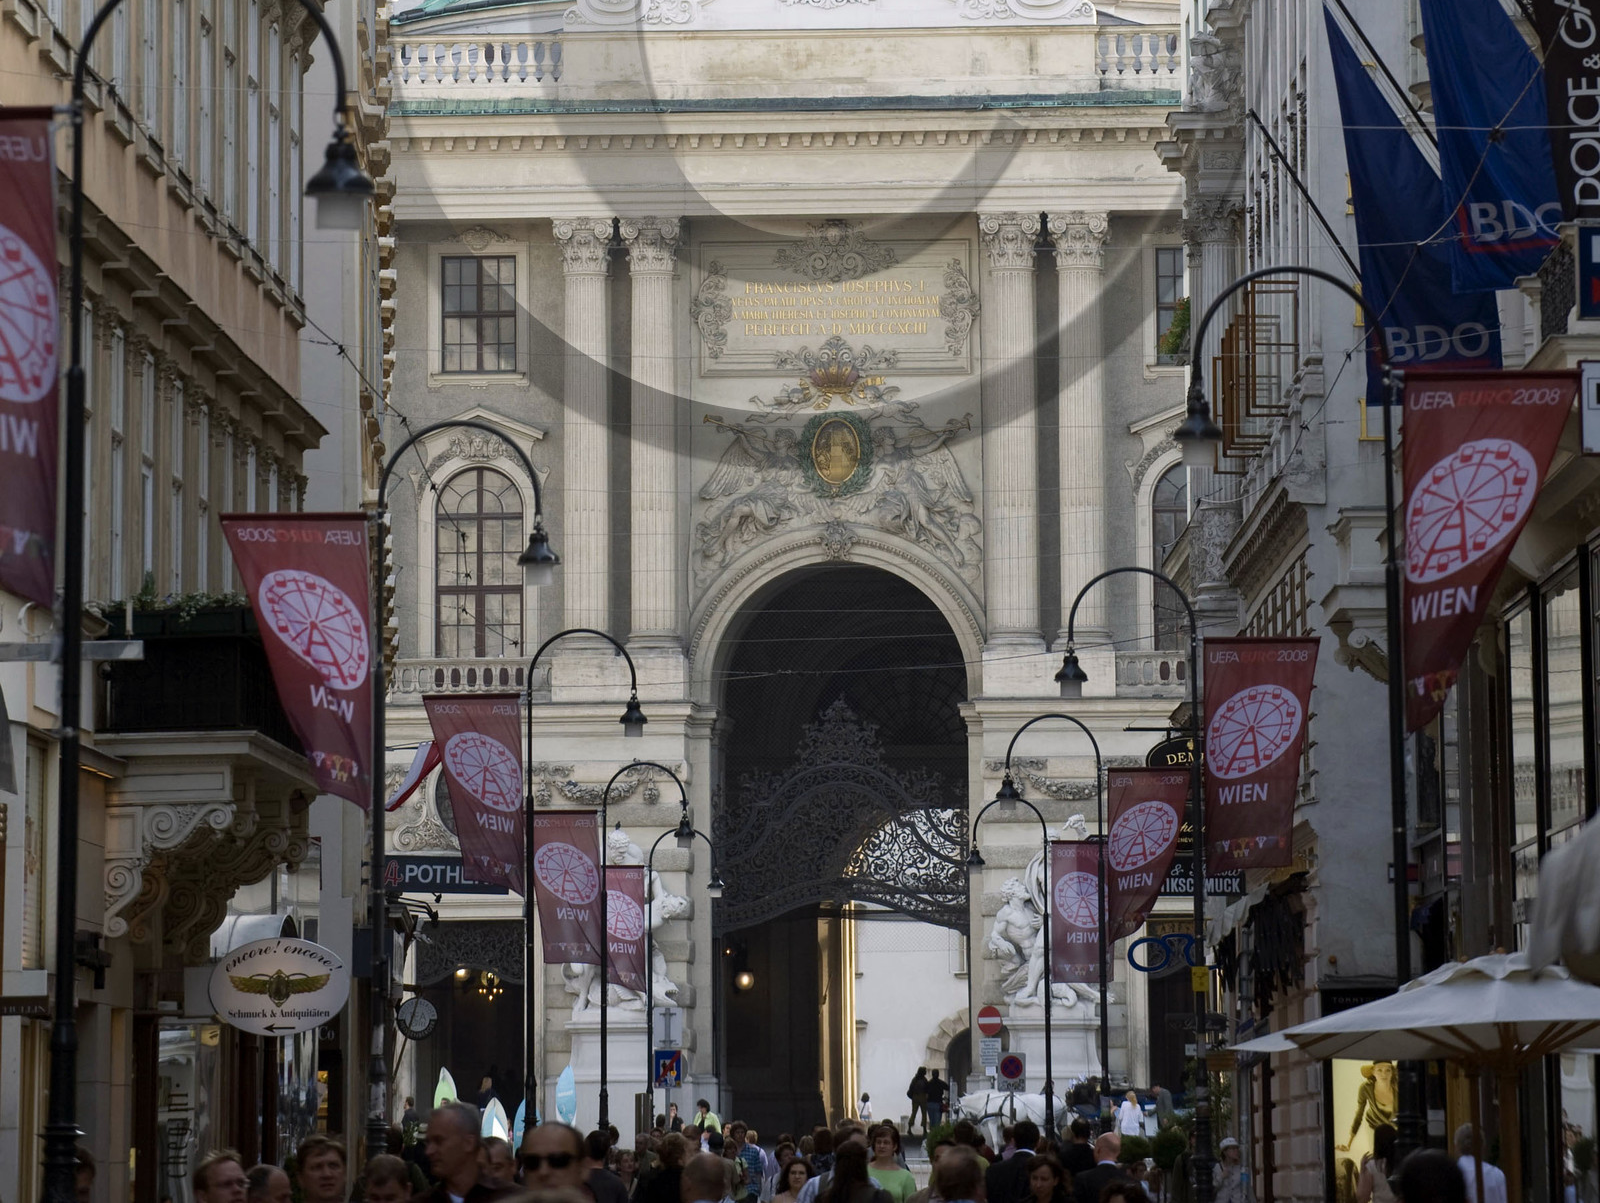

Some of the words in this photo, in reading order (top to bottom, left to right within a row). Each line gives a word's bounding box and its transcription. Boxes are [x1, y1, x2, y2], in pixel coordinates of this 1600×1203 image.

[1567, 77, 1600, 205] DOLCE
[745, 281, 834, 294] FRANCISCVS
[842, 280, 912, 293] IOSEPHVS
[744, 323, 811, 335] PERFECIT
[849, 321, 928, 334] MDCCCXCIII
[1384, 322, 1490, 362] BDO
[1409, 390, 1455, 411] UEFA
[1511, 387, 1562, 405] 2008
[1411, 585, 1478, 625] WIEN
[1209, 651, 1240, 664] UEFA
[1276, 649, 1309, 662] 2008
[1219, 783, 1268, 805] WIEN
[1118, 872, 1154, 891] WIEN
[225, 940, 281, 973] encore!
[284, 945, 343, 971] encore!
[228, 1009, 267, 1019] Schmuck
[279, 1008, 330, 1020] Antiquitäten
